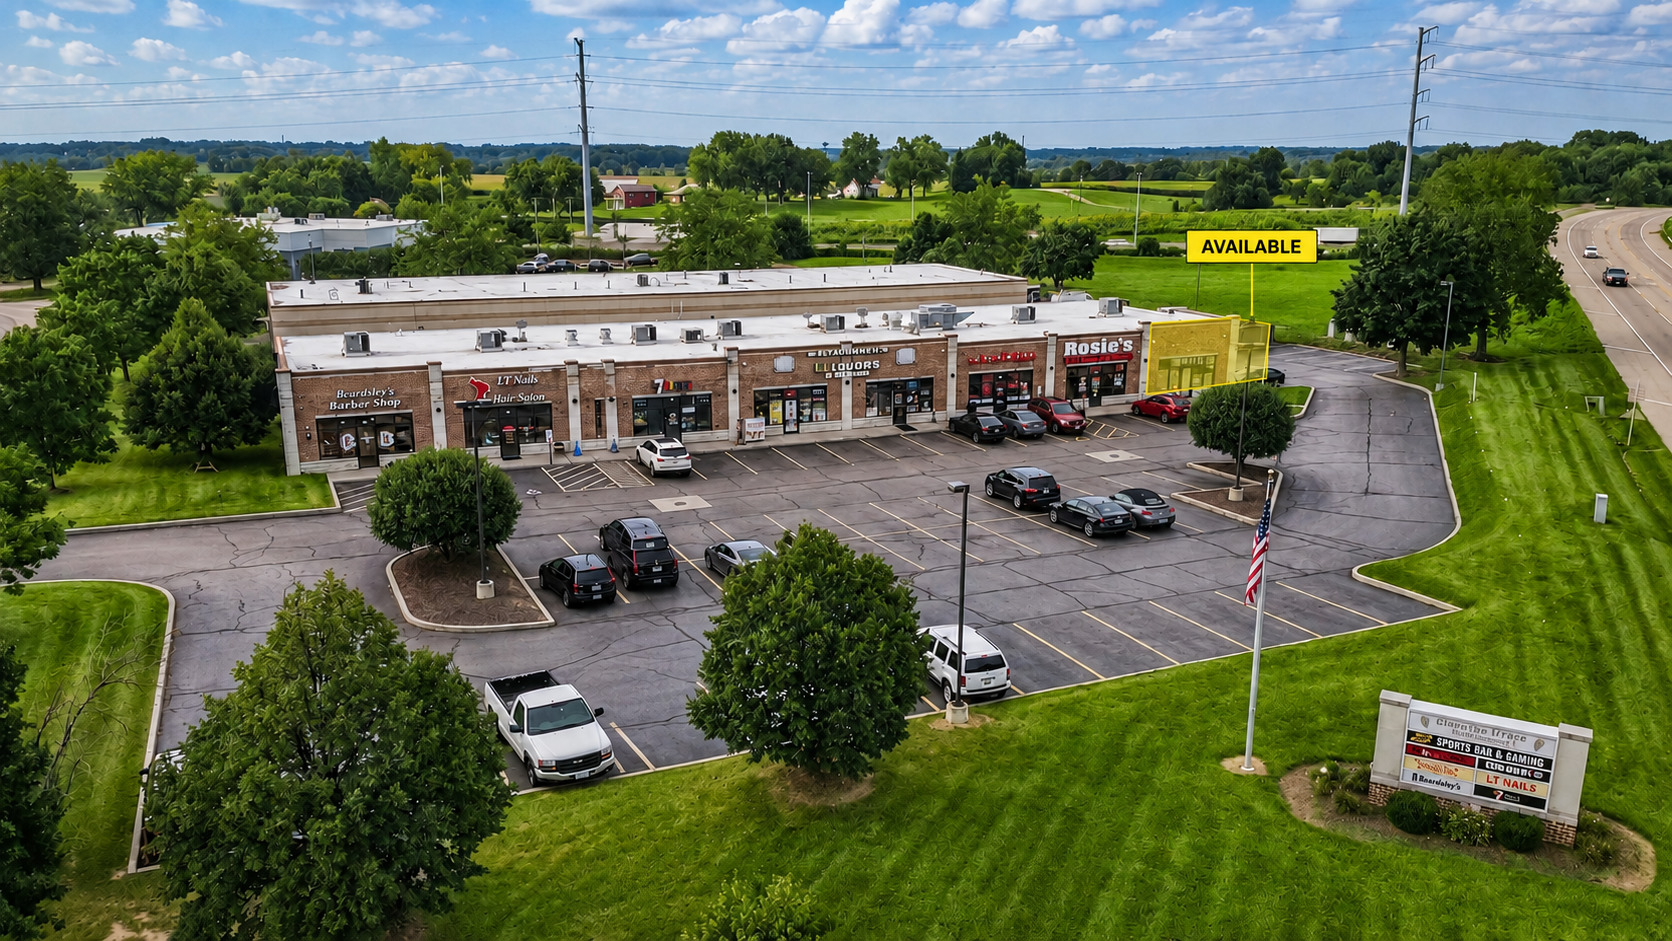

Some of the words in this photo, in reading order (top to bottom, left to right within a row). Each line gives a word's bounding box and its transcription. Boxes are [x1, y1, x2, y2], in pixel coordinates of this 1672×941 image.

[1064, 337, 1134, 356] Rosie's
[497, 375, 512, 386] LT
[513, 374, 539, 385] Nails
[329, 399, 370, 411] Barber
[373, 398, 401, 409] Shop
[493, 393, 515, 404] Hair
[517, 392, 545, 402] Salon
[1436, 737, 1471, 753] SPORTS
[1474, 745, 1493, 758] BAR
[1505, 751, 1545, 768] GAMING
[1486, 774, 1500, 785] LT
[1503, 778, 1537, 793] NAILS
